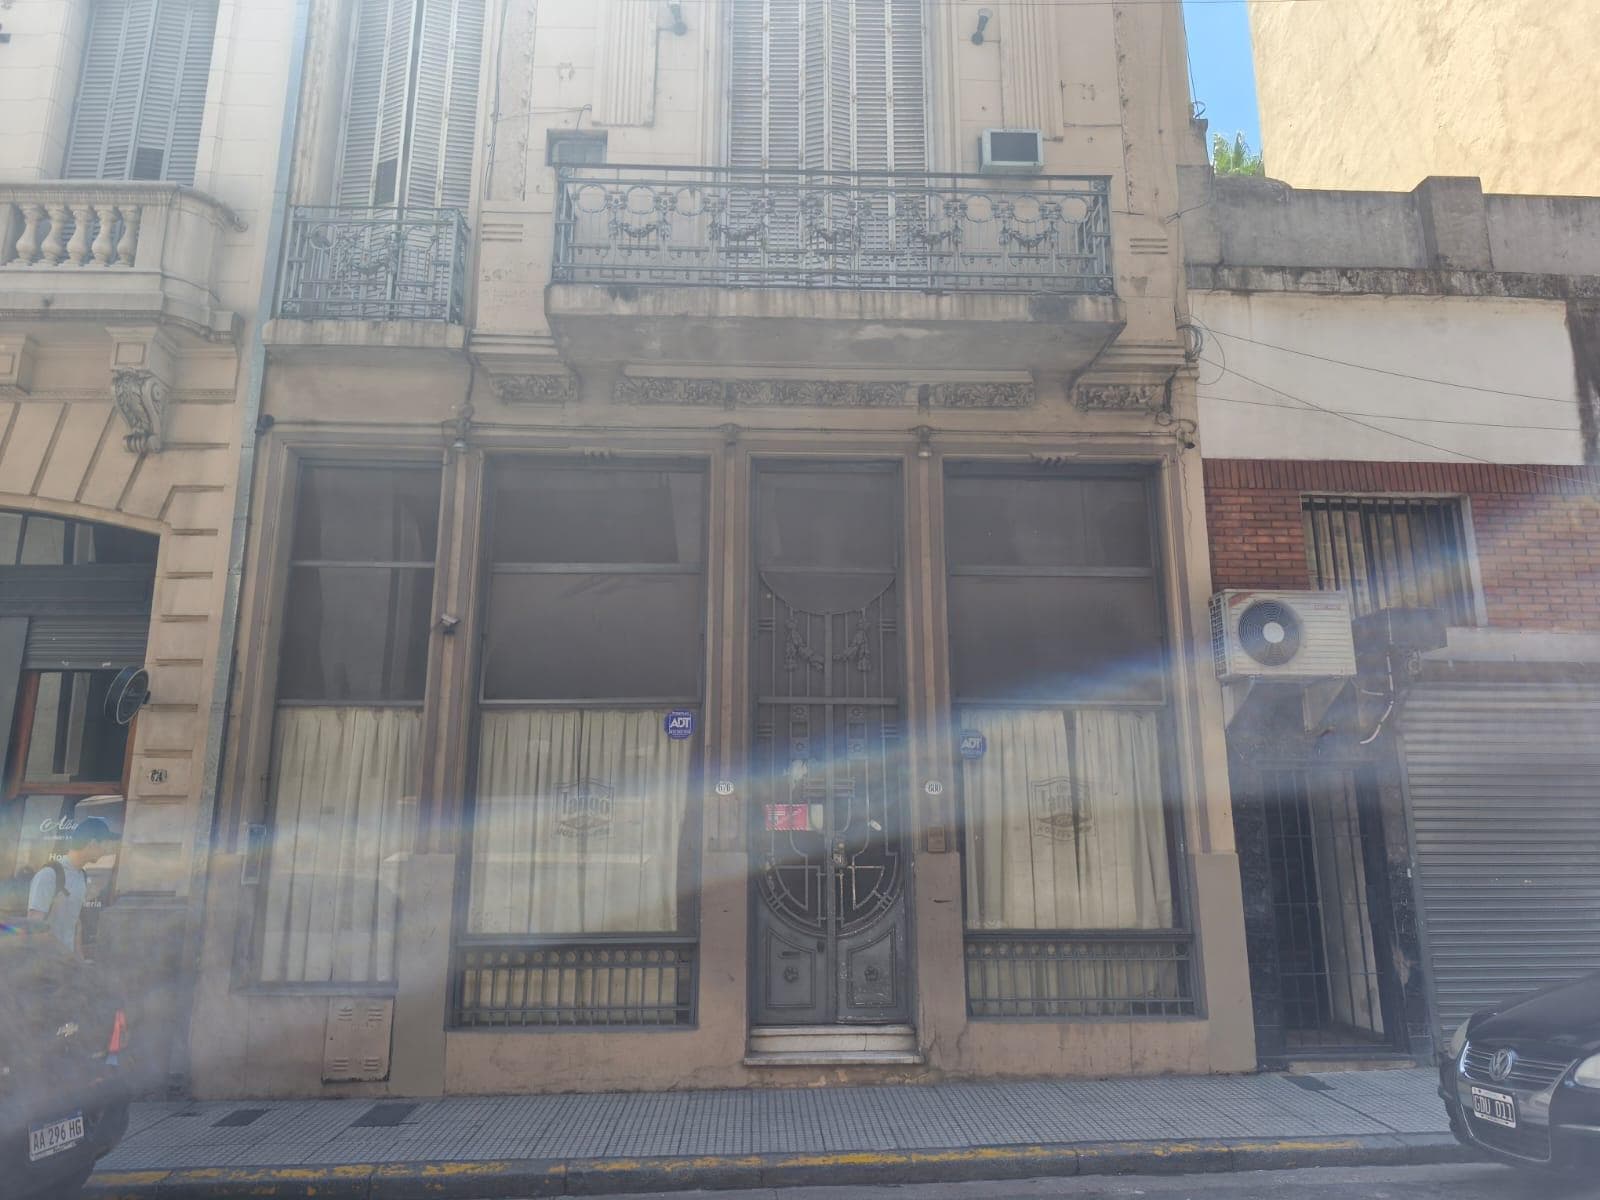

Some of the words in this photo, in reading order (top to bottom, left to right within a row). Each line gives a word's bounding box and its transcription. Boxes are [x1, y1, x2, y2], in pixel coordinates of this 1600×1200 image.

[671, 717, 690, 728] ADT
[960, 737, 981, 750] ADT
[33, 1131, 46, 1151] AA
[48, 1123, 67, 1146] 296
[69, 1119, 82, 1138] HG
